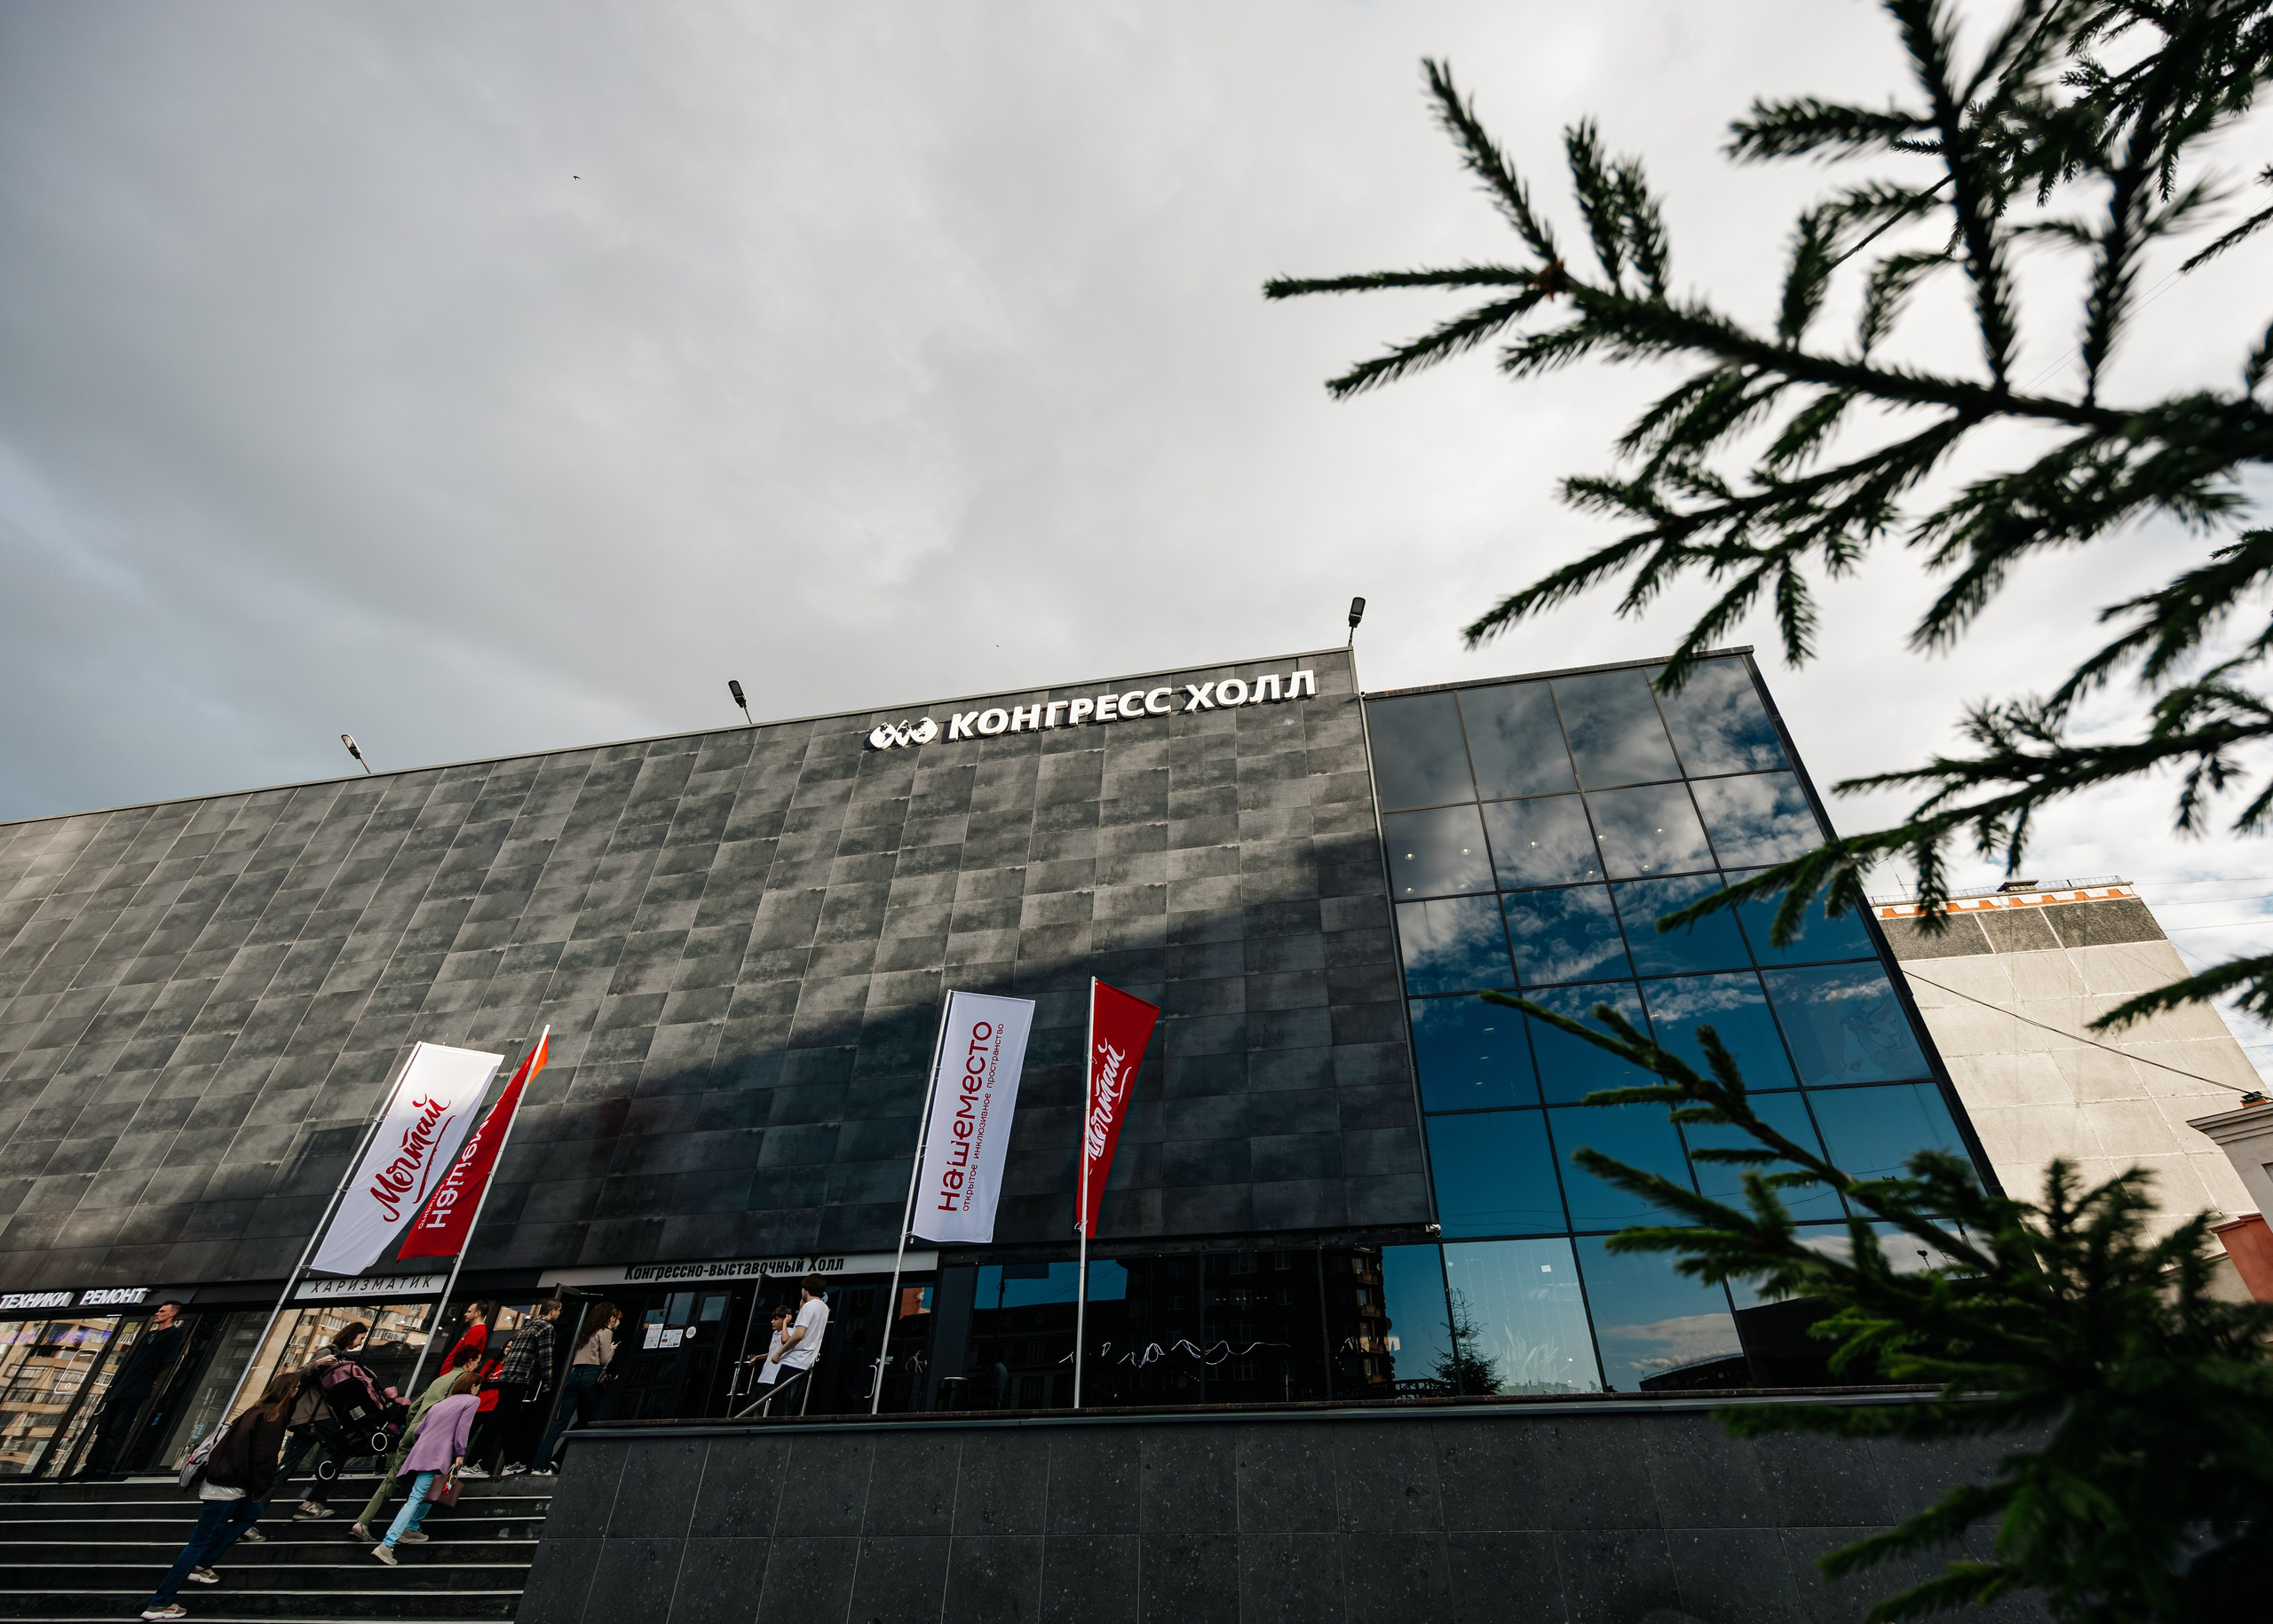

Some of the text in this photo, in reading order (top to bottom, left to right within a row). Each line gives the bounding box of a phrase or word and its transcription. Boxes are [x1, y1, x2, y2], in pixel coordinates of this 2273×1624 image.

[948, 669, 1319, 741] КОНГРЕСС ХОЛЛ
[962, 1023, 1004, 1212] открытое инклюзивное пространство
[369, 1093, 452, 1223] Мечтай
[311, 1275, 433, 1294] ХАРИЗМАТИК
[624, 1256, 844, 1281] Конгрессно-выставочный Холл
[0, 1288, 152, 1309] ТЕХНИКИ РЕМОНТ
